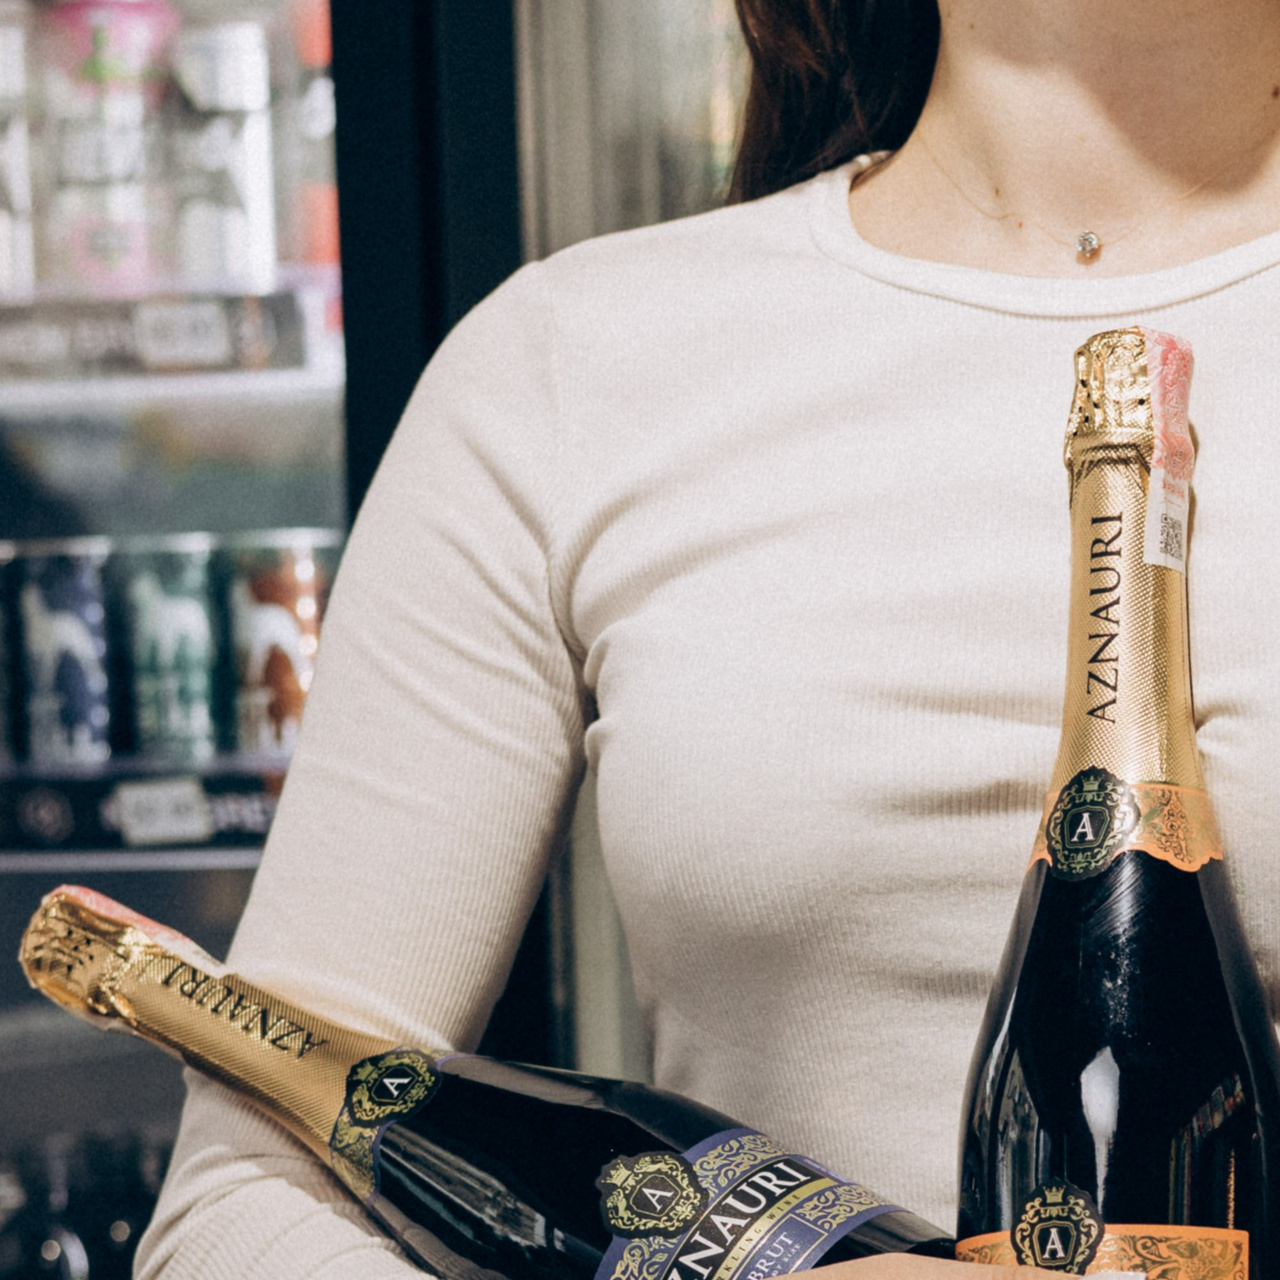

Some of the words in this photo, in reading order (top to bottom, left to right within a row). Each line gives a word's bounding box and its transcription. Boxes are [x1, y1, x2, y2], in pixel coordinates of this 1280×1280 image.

[1086, 512, 1123, 724] AZNAURI
[1071, 812, 1095, 842] A
[162, 963, 328, 1058] AZNAURI
[383, 1075, 412, 1098] A
[641, 1184, 675, 1212] A
[767, 1194, 801, 1222] WINE
[1042, 1227, 1065, 1259] A
